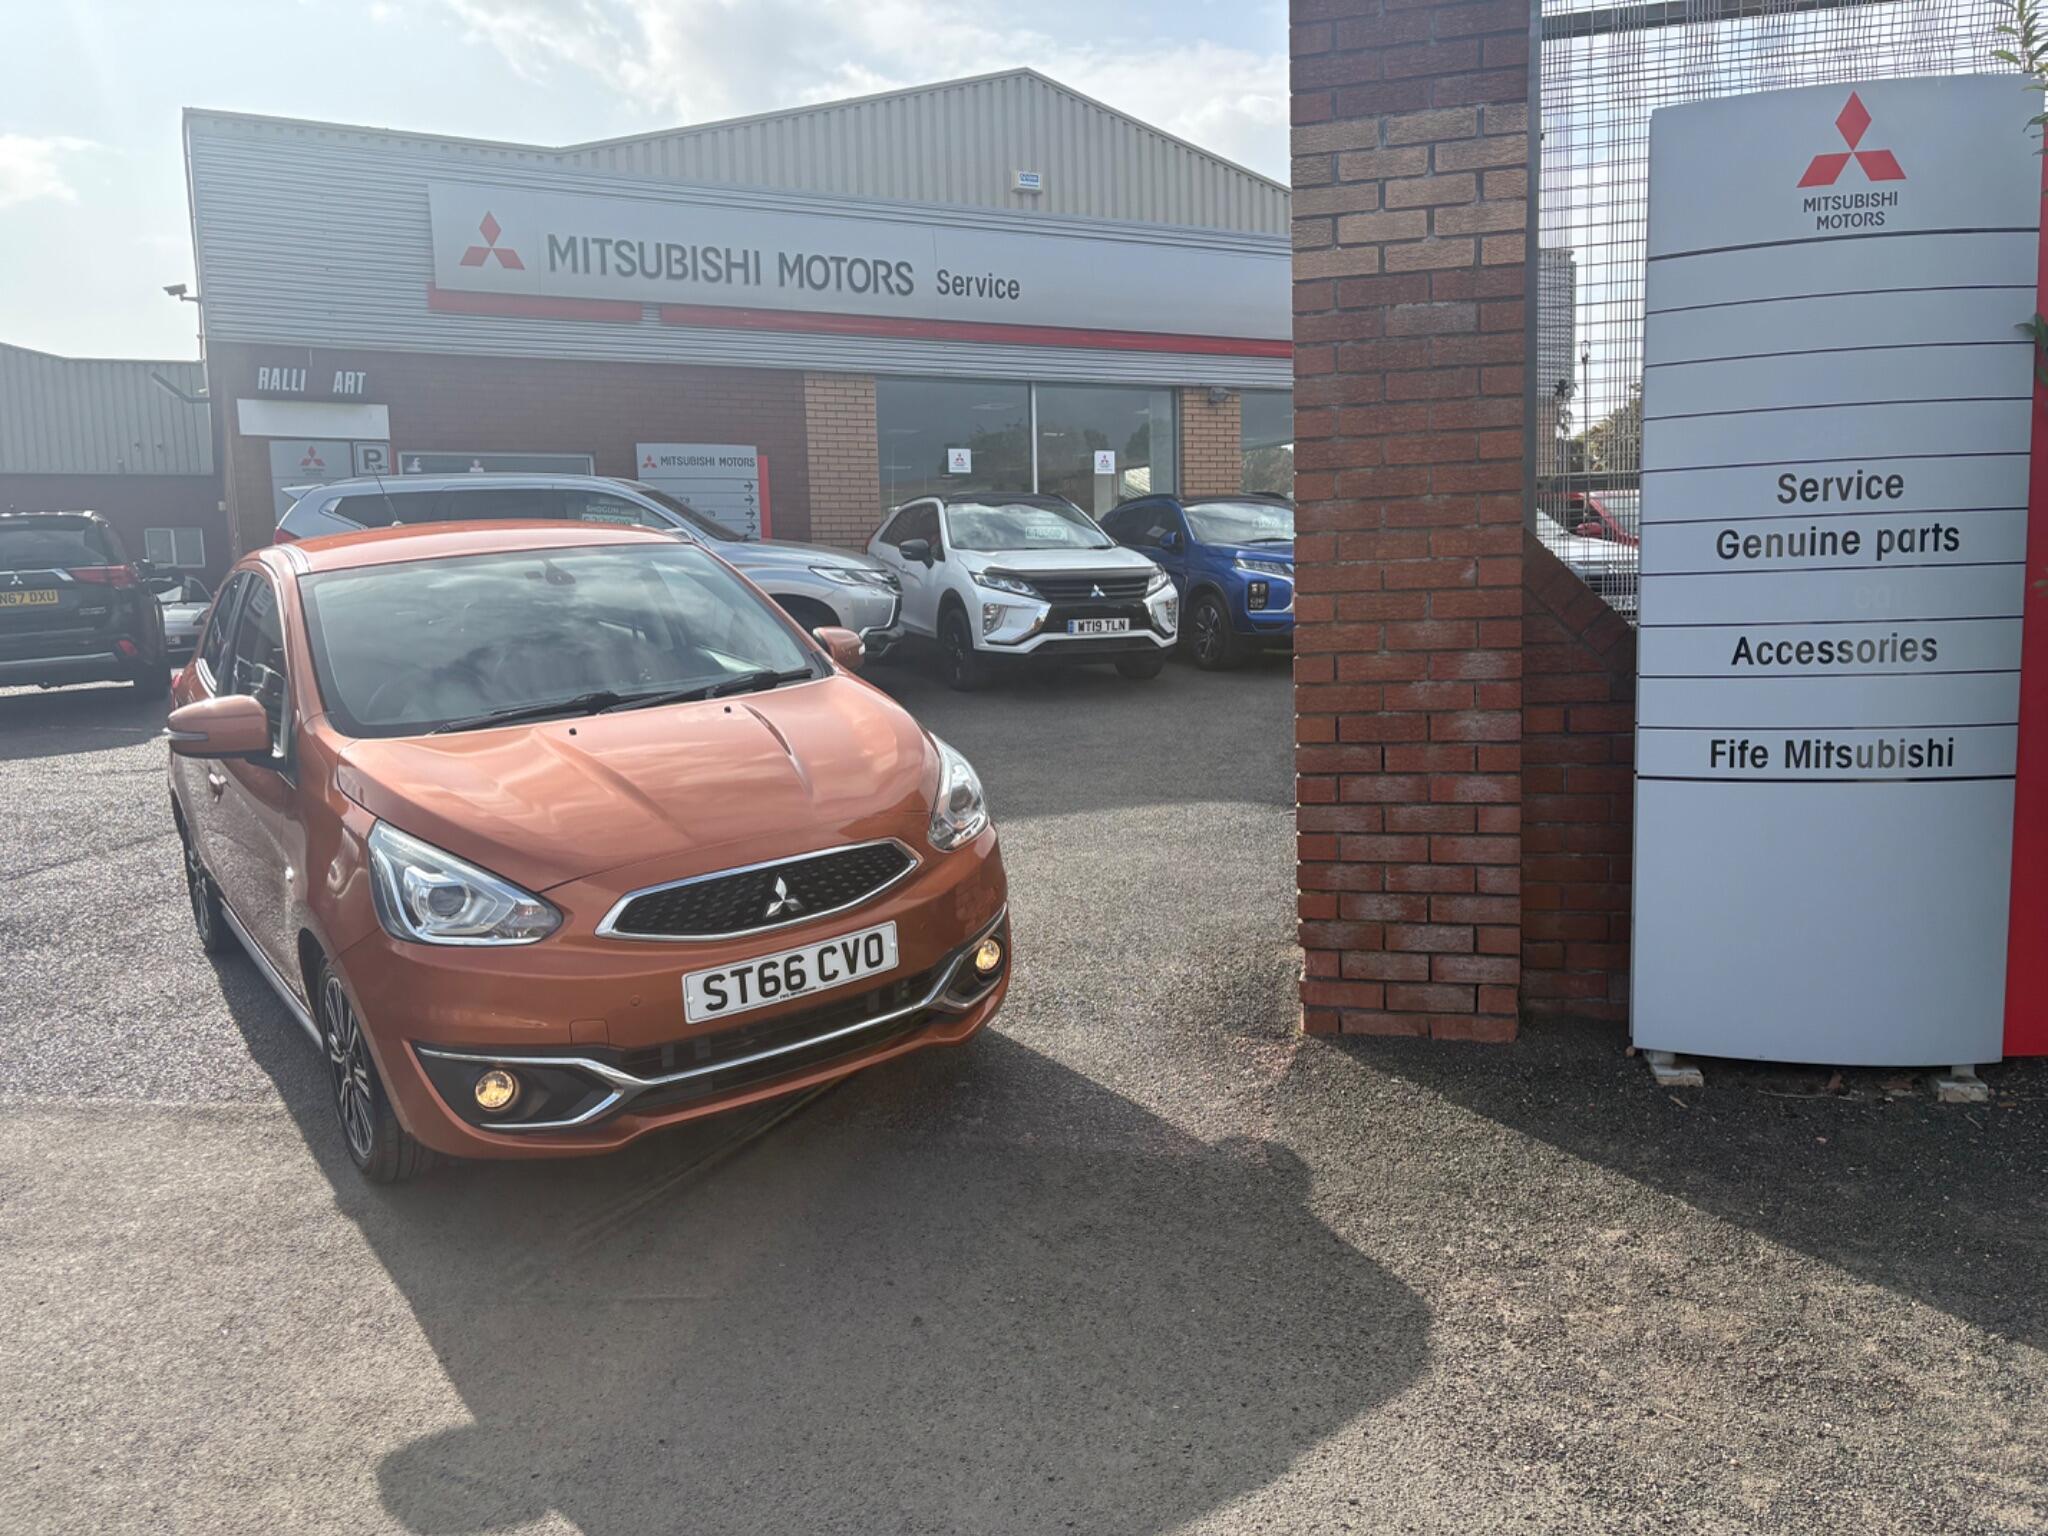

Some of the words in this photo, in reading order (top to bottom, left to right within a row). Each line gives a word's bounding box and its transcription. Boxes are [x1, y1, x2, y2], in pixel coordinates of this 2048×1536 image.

[1803, 191, 1898, 212] MITSUBISHI
[1816, 211, 1885, 230] MOTORS
[547, 233, 761, 286] MITSUBISHI
[778, 251, 914, 296] MOTORS
[936, 269, 1020, 300] Service
[258, 366, 306, 392] RALLI
[332, 370, 367, 394] ART
[660, 455, 715, 467] MITSUBISHI
[719, 456, 756, 468] MOTORS
[1776, 469, 1905, 504] Service
[1716, 525, 1861, 560] Genuine
[1876, 522, 1961, 562] parts
[1104, 619, 1126, 631] TLN
[1731, 632, 1938, 667] Accessories
[1709, 738, 1769, 769] Fife
[1784, 737, 1955, 769] Mitsubishi
[703, 955, 807, 1012] ST66
